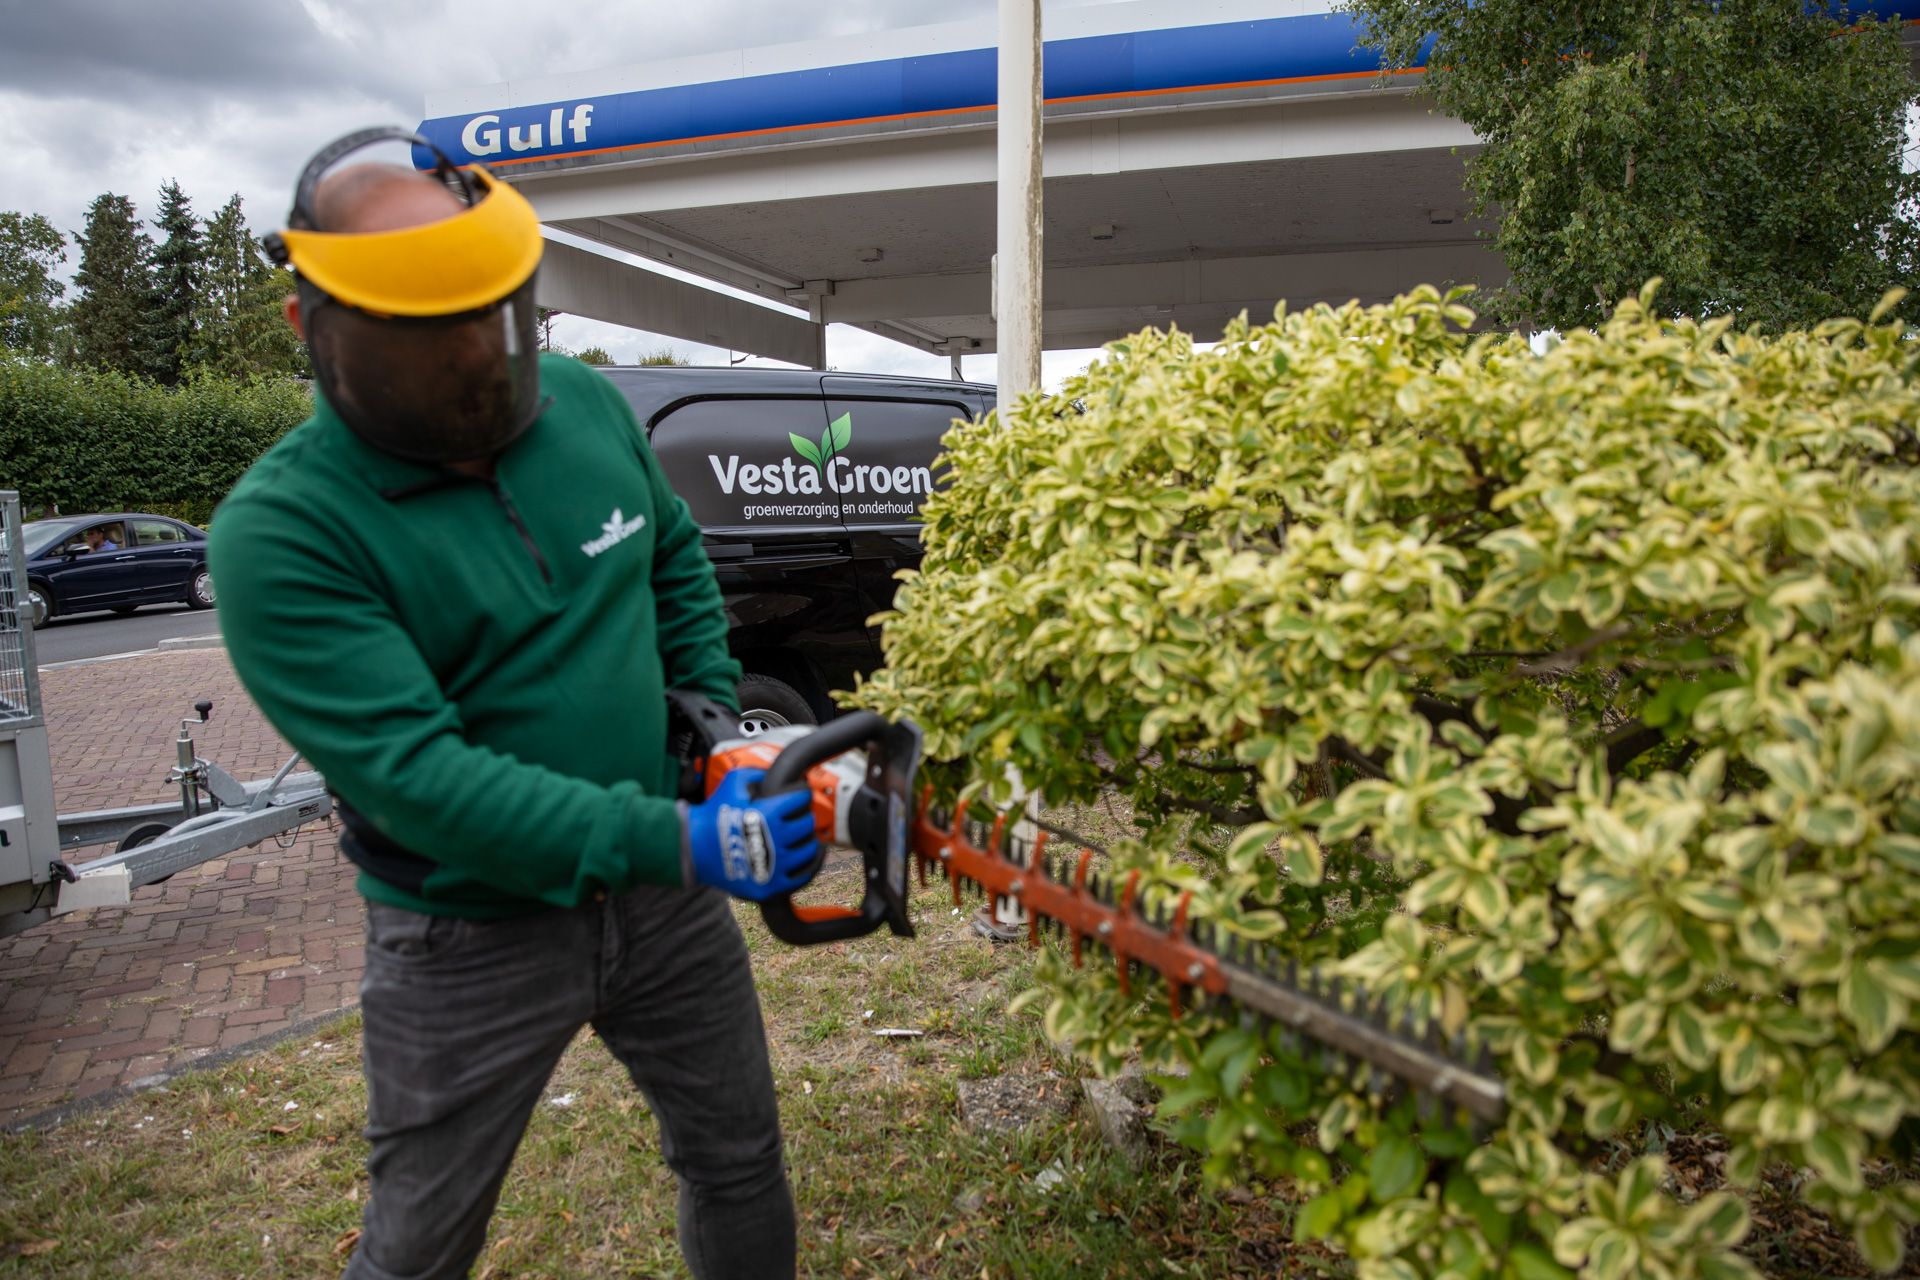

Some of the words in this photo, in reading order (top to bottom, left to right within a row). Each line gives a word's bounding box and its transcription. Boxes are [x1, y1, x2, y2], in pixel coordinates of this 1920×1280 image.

[461, 104, 594, 156] Gulf
[708, 455, 823, 495] Vesta
[826, 456, 934, 494] Groen
[743, 502, 839, 520] groenverzorging
[842, 503, 855, 514] en
[858, 500, 914, 515] onderhoud
